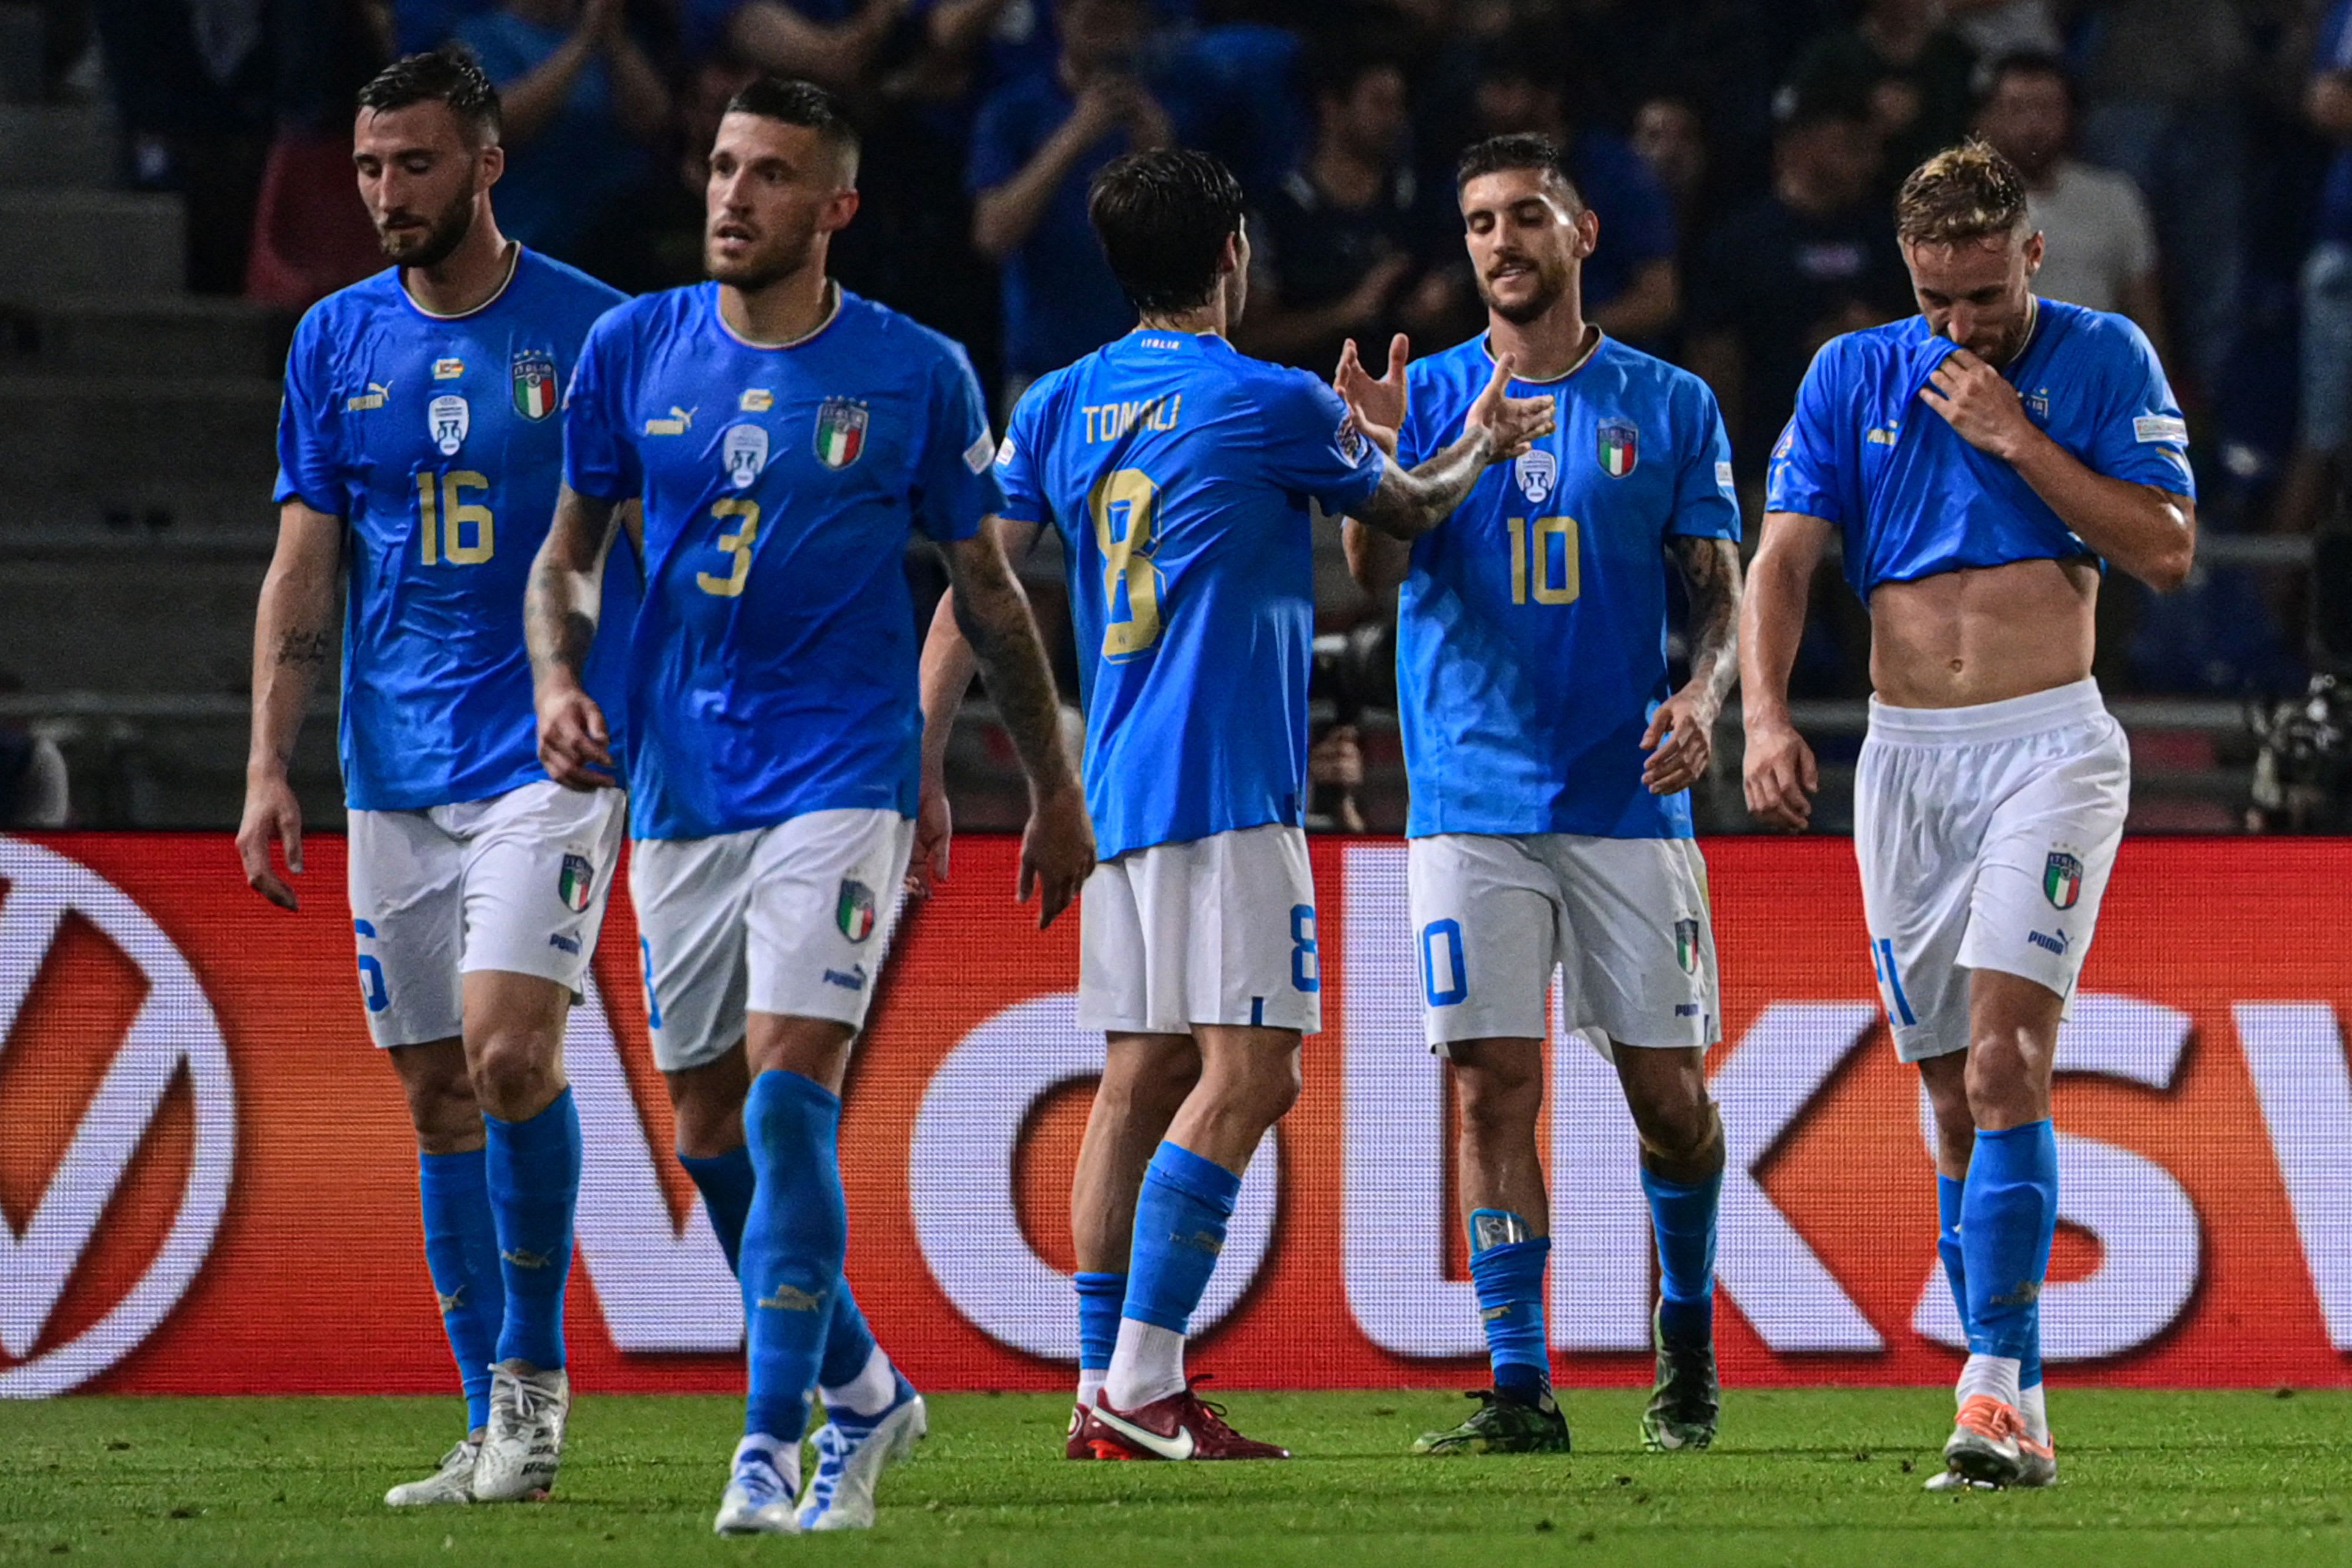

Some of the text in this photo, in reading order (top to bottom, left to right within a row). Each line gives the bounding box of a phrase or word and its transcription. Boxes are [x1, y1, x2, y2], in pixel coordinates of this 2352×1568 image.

[416, 471, 494, 566] 16
[697, 498, 760, 597] 3
[1507, 516, 1580, 605] 10
[1087, 469, 1167, 664] 8
[1290, 904, 1319, 992] 8
[1416, 918, 1468, 1011] 0
[562, 844, 2352, 1361] Volks
